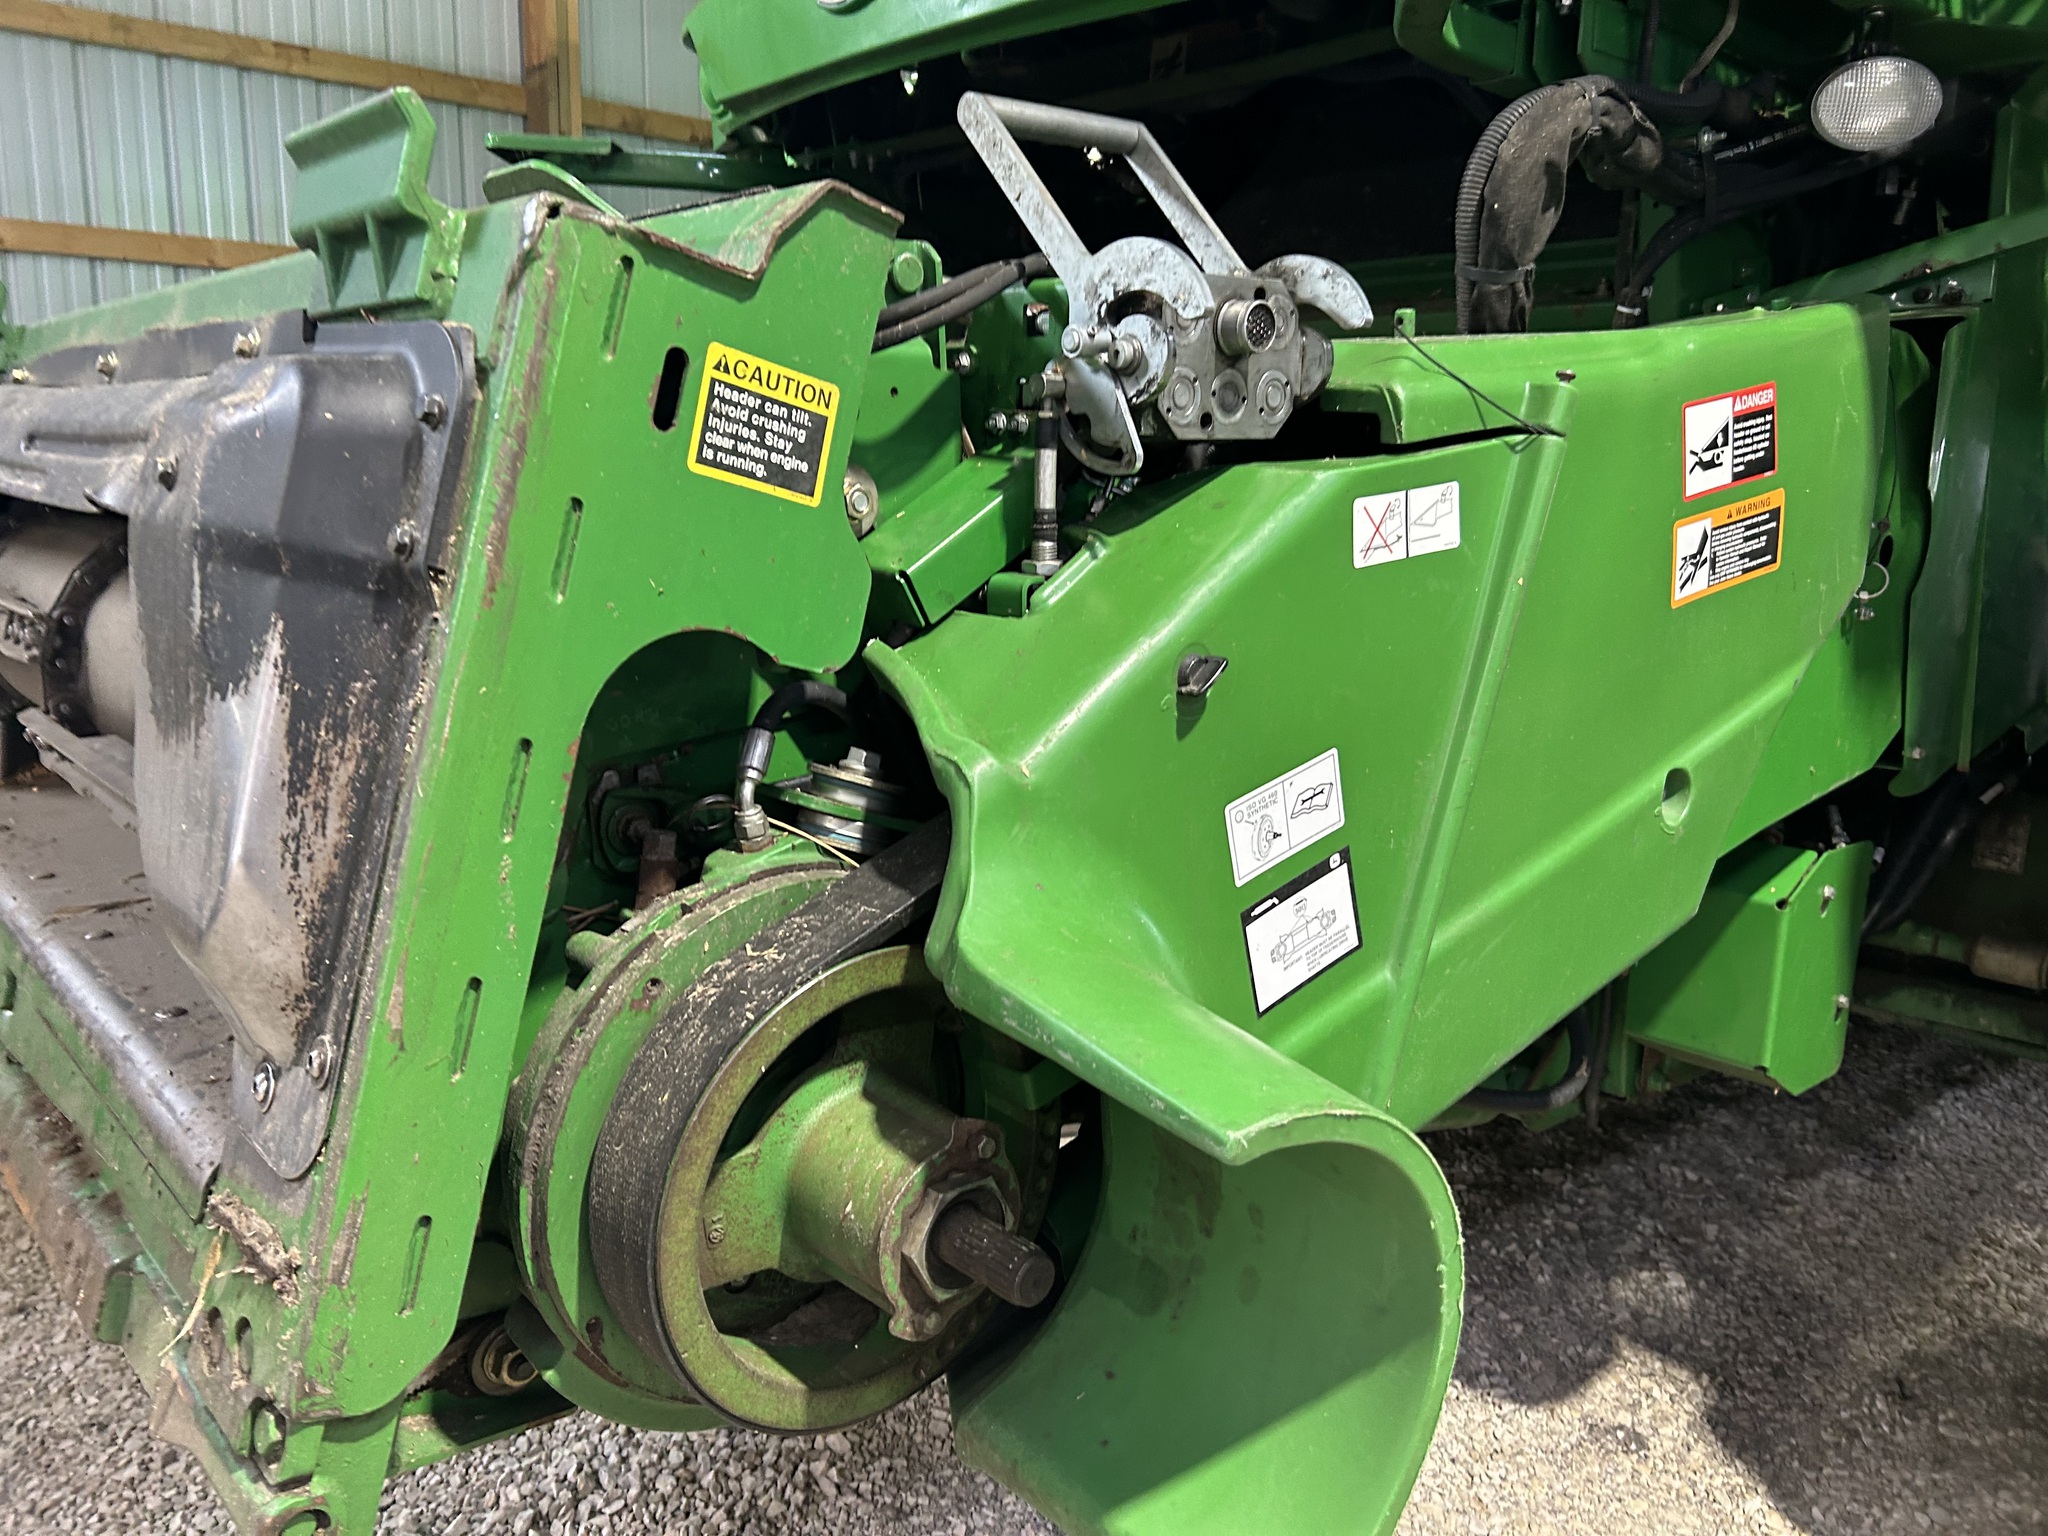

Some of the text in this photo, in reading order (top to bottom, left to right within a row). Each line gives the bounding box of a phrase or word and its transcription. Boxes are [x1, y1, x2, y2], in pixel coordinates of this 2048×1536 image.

[733, 360, 832, 410] CAUTION
[1741, 388, 1774, 410] DANGER
[711, 398, 807, 443] Avoid crushing
[713, 381, 812, 427] Header can tilt.
[704, 431, 809, 473] clear when engine
[764, 432, 793, 454] Stay
[702, 444, 767, 478] is running.
[1735, 497, 1771, 516] WARNING
[1247, 797, 1279, 819] SYNTHETIC
